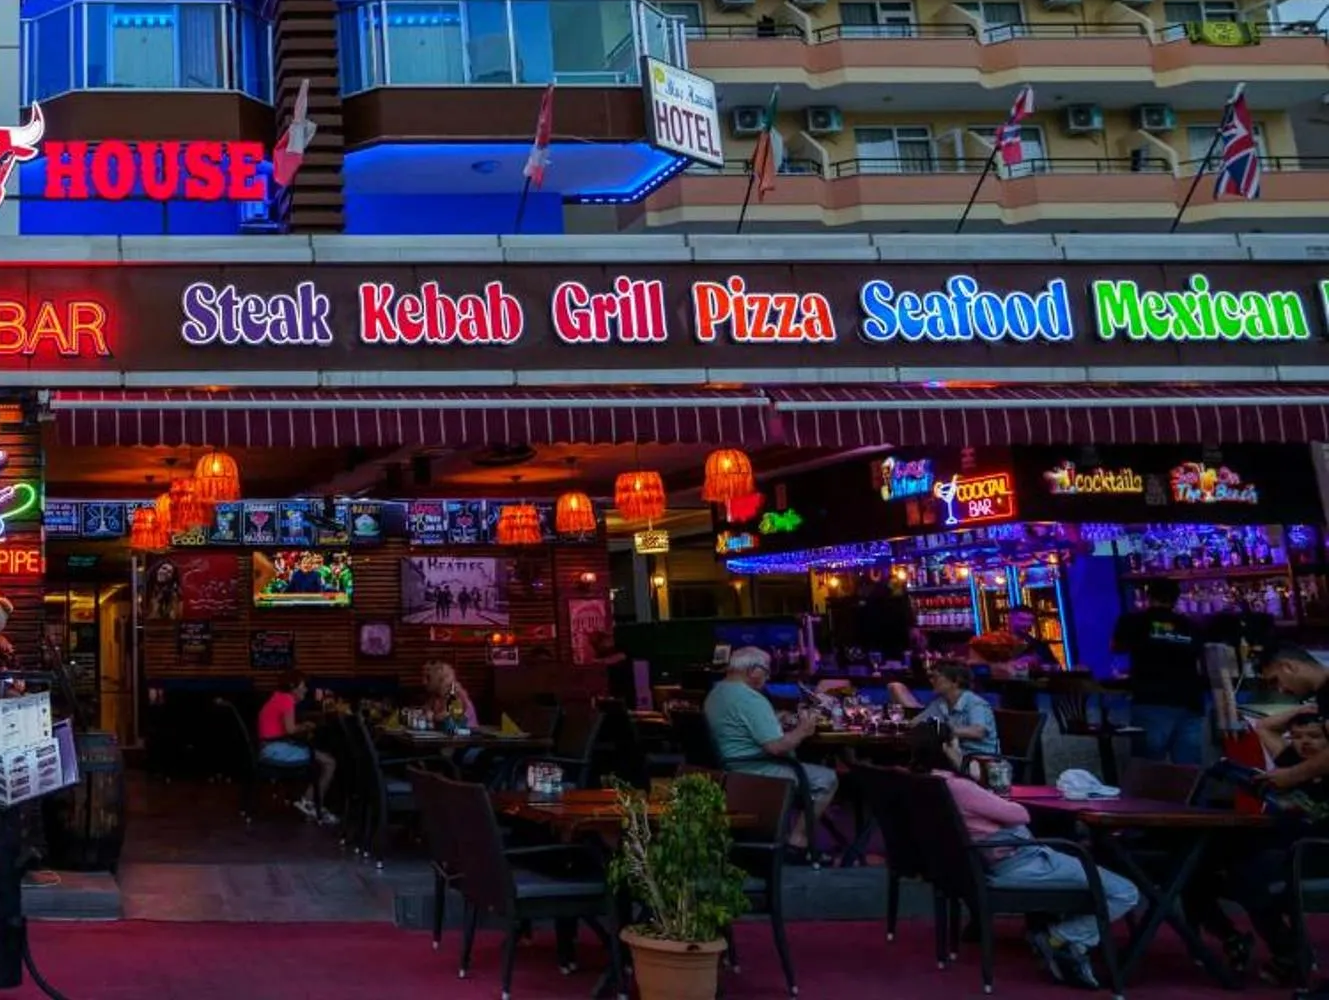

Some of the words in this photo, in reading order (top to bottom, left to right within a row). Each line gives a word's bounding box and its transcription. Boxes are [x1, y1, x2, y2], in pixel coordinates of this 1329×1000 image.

[655, 100, 720, 157] HOTEL
[44, 140, 266, 200] HOUSE
[181, 282, 333, 344] Steak
[359, 281, 524, 344] Kebab
[553, 276, 668, 343] Grill
[692, 275, 836, 342] Pizza
[860, 275, 1074, 341] Seafood
[1093, 274, 1309, 340] Mexican
[957, 478, 1007, 502] COCKTAIL
[969, 499, 994, 517] BAR
